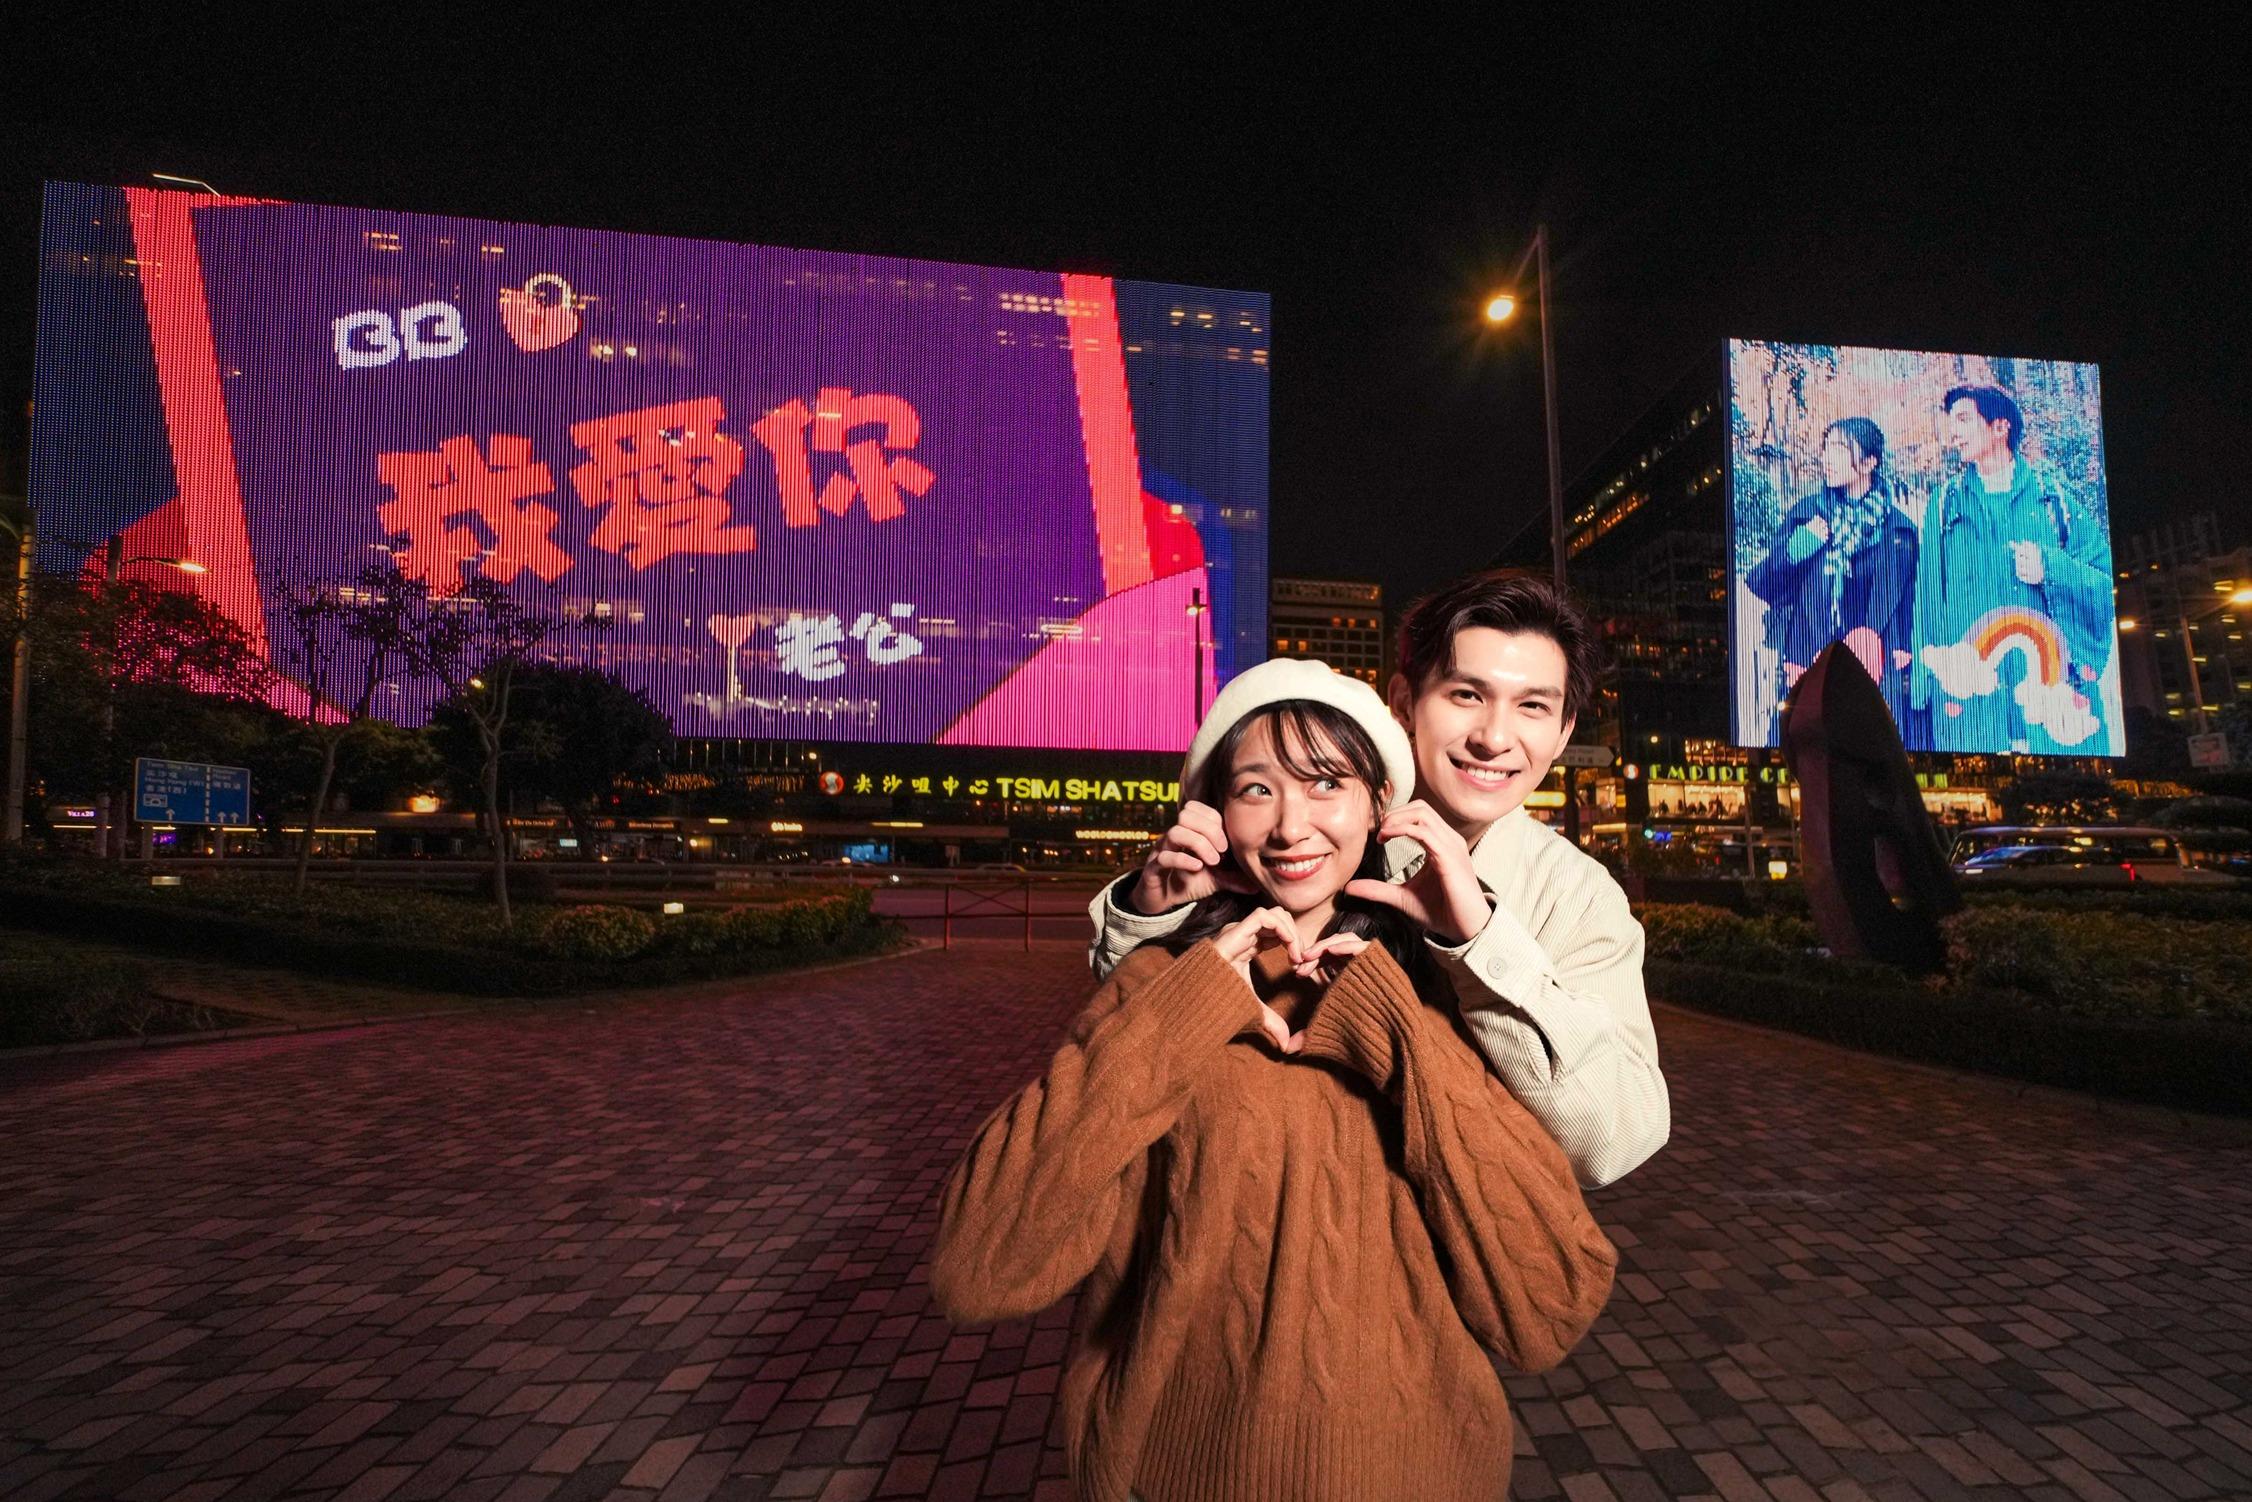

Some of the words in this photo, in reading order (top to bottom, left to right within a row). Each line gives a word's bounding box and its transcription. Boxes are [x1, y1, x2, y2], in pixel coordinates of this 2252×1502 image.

[377, 387, 936, 599] 我愛你
[775, 603, 922, 681] 老公
[853, 773, 989, 798] 尖沙咀中心
[996, 777, 1060, 799] TSIM
